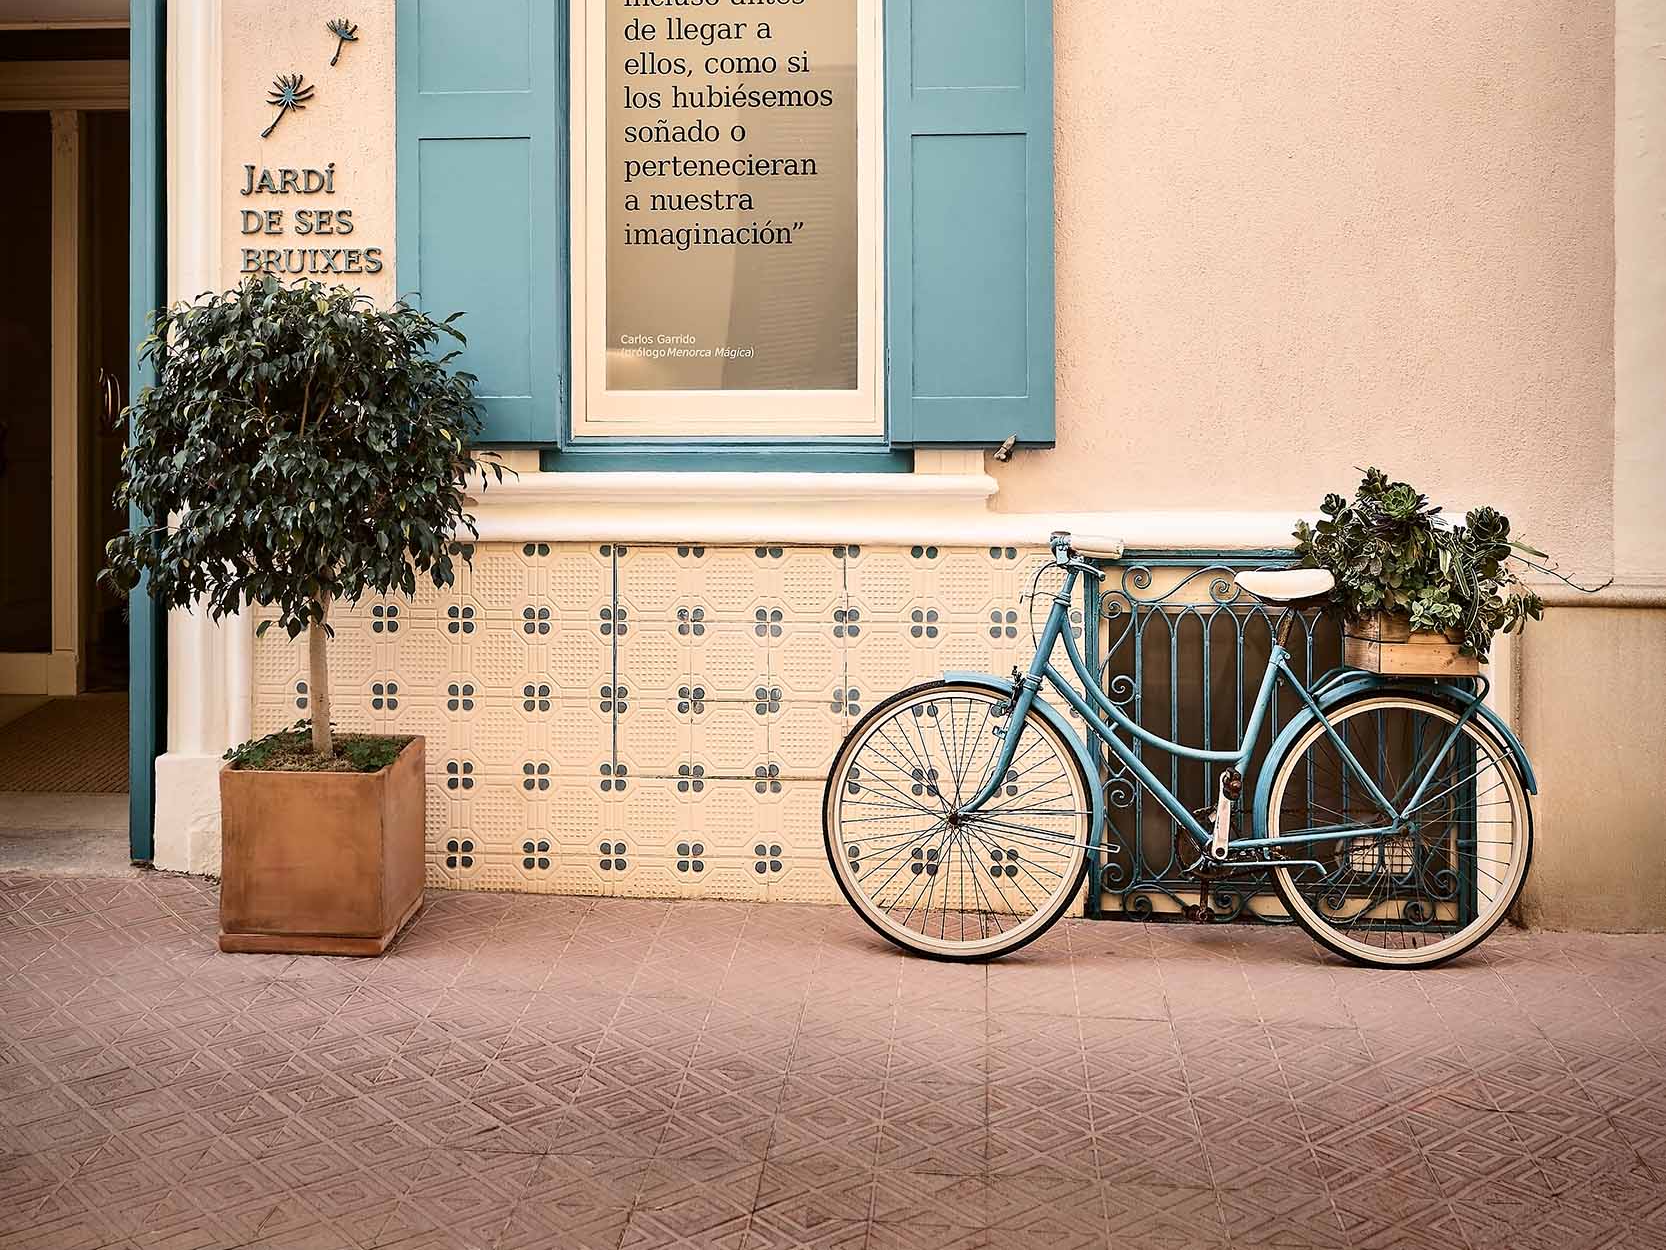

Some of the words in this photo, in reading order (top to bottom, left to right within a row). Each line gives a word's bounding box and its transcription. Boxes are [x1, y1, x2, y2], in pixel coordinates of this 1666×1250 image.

[624, 18, 656, 41] de
[666, 17, 748, 46] llegar
[756, 22, 773, 40] a
[624, 51, 694, 78] ellos,
[704, 56, 777, 75] como
[787, 50, 810, 74] si
[623, 85, 661, 109] los
[671, 83, 833, 108] hubiésemos
[624, 119, 720, 143] soñado
[730, 125, 746, 142] o
[240, 162, 335, 196] JARDÍ
[624, 153, 818, 183] pertenecieran
[624, 194, 641, 211] a
[650, 189, 755, 211] nuestra
[240, 209, 283, 235] DE
[294, 209, 354, 236] SES
[624, 220, 804, 251] imaginación”
[240, 248, 383, 274] BRUIXES
[620, 334, 653, 344] Carlos
[657, 334, 696, 344] Garrido
[667, 348, 711, 357] Menorca
[714, 347, 754, 359] Mágica)
